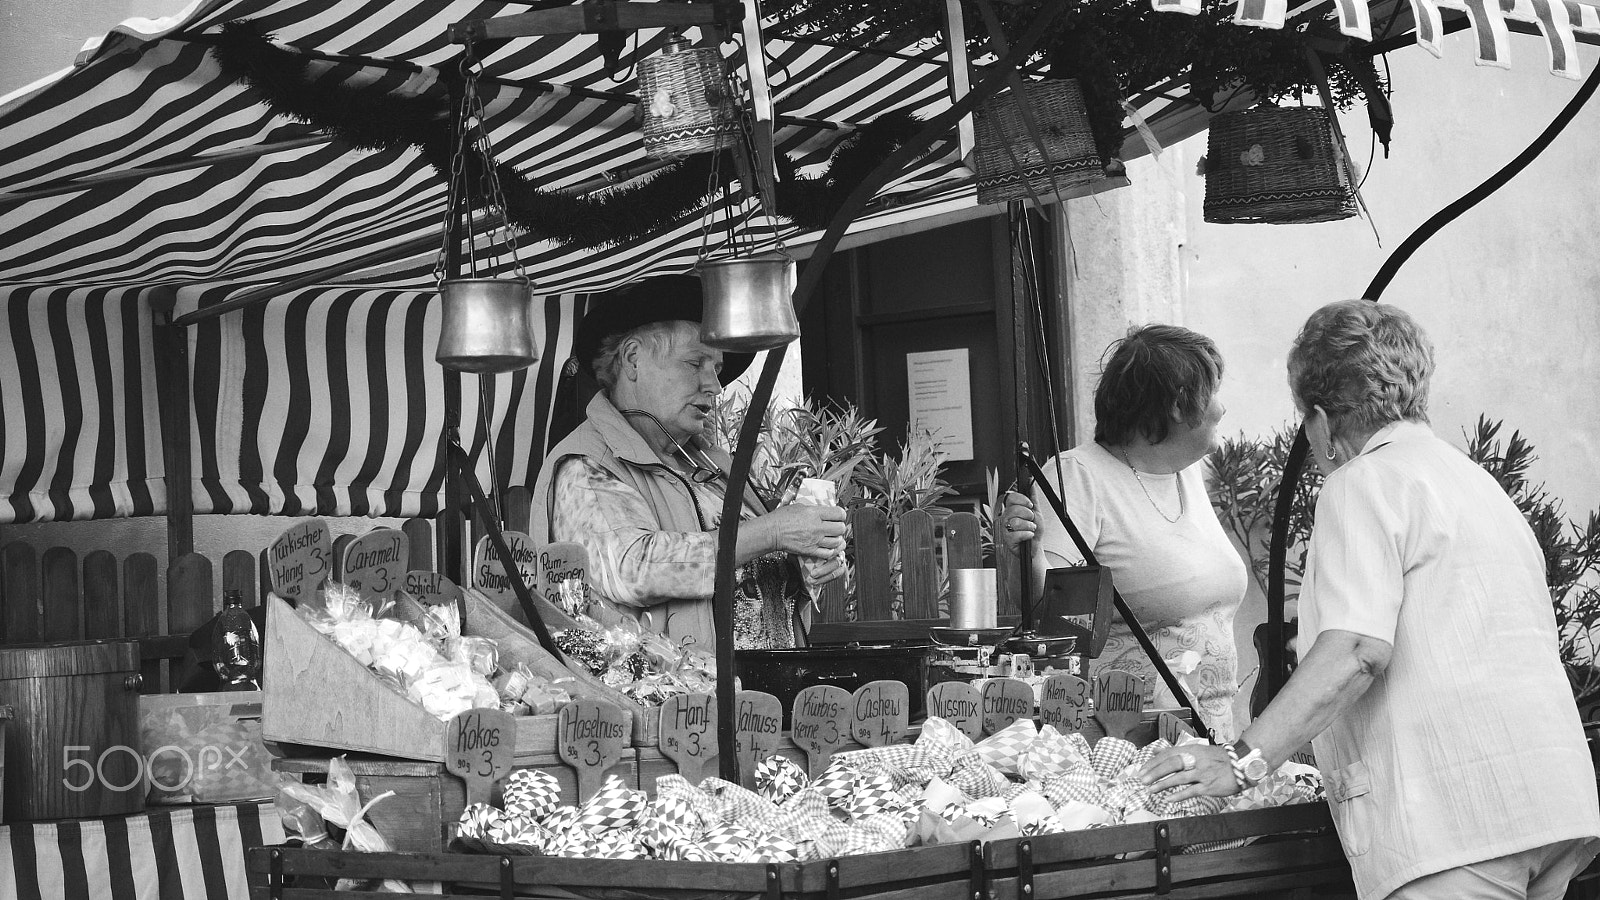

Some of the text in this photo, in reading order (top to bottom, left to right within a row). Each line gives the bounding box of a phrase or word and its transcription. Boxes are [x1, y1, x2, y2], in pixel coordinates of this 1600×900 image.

[271, 525, 323, 563] Türkischer
[345, 537, 400, 574] Caramell
[484, 537, 501, 561] Ru
[276, 559, 303, 588] Honig
[540, 552, 568, 572] Rum-
[406, 574, 442, 595] Schicht
[855, 687, 900, 722] Cashew
[931, 685, 978, 719] Nussmix
[983, 681, 1028, 715] Erdnuss
[1095, 675, 1141, 713] Mandeln
[565, 704, 624, 743] Haselnuss
[675, 696, 711, 734] Hanf
[457, 713, 500, 753] Kokos
